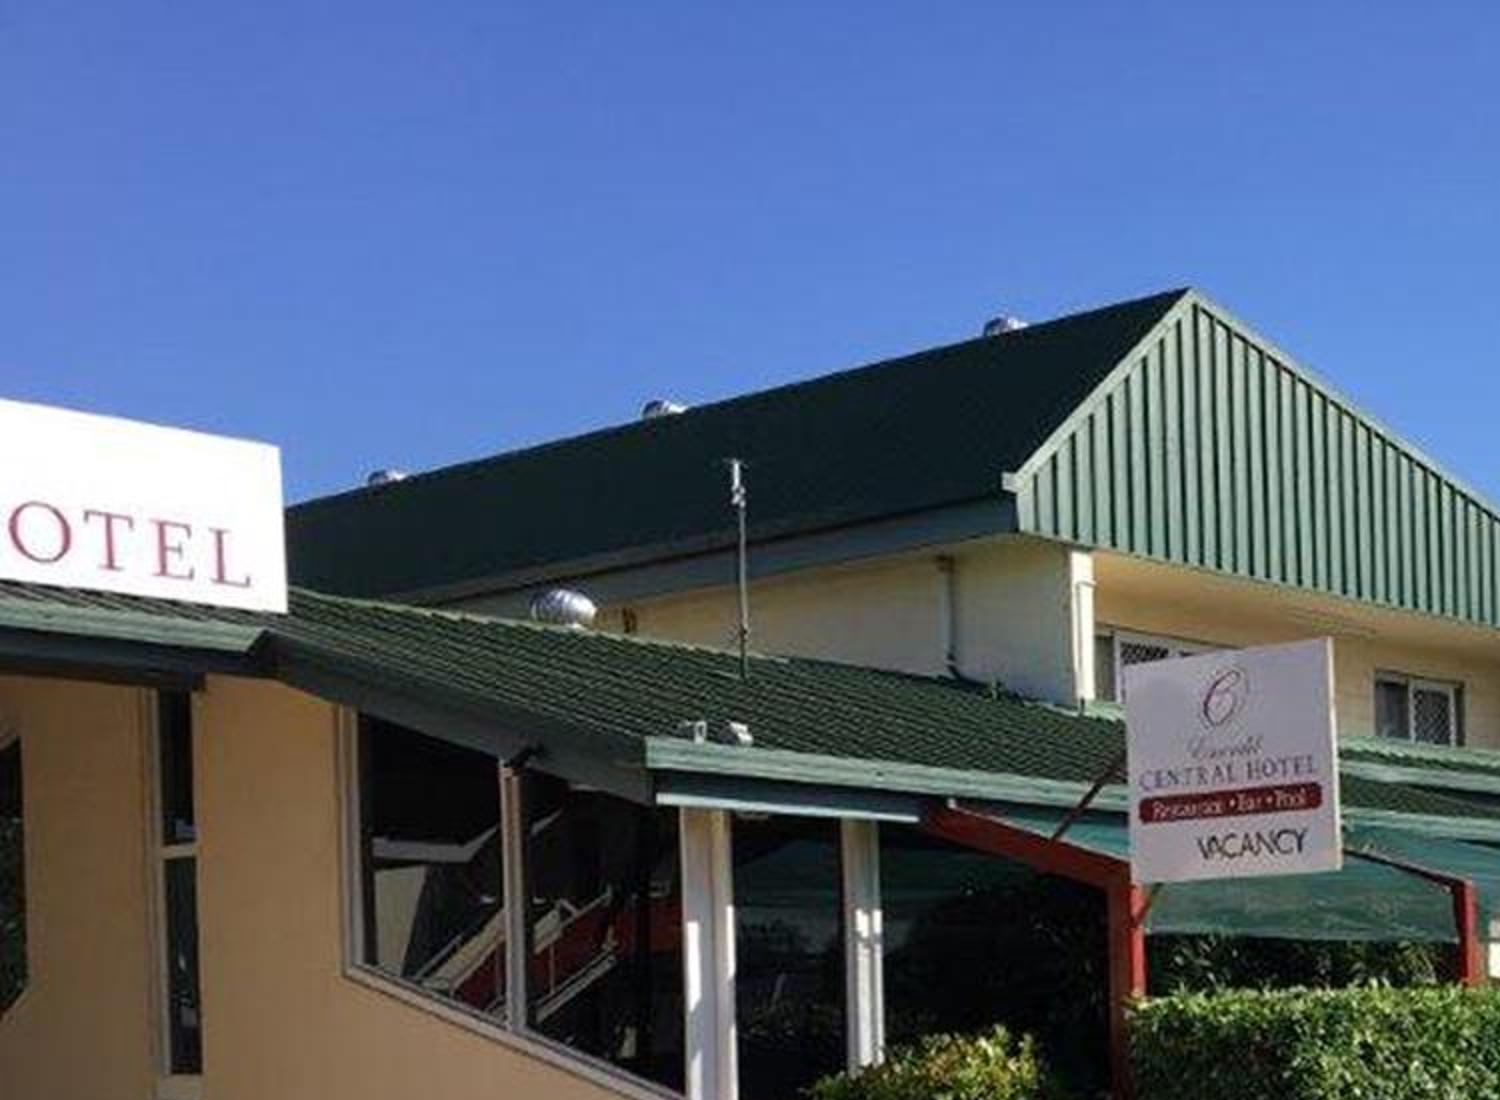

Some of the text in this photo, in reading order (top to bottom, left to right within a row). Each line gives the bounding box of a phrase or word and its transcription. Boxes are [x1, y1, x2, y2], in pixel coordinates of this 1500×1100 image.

[8, 500, 252, 589] OTEL
[1139, 754, 1318, 791] CENTRAL HOTEL
[1197, 827, 1309, 860] VACANCY
